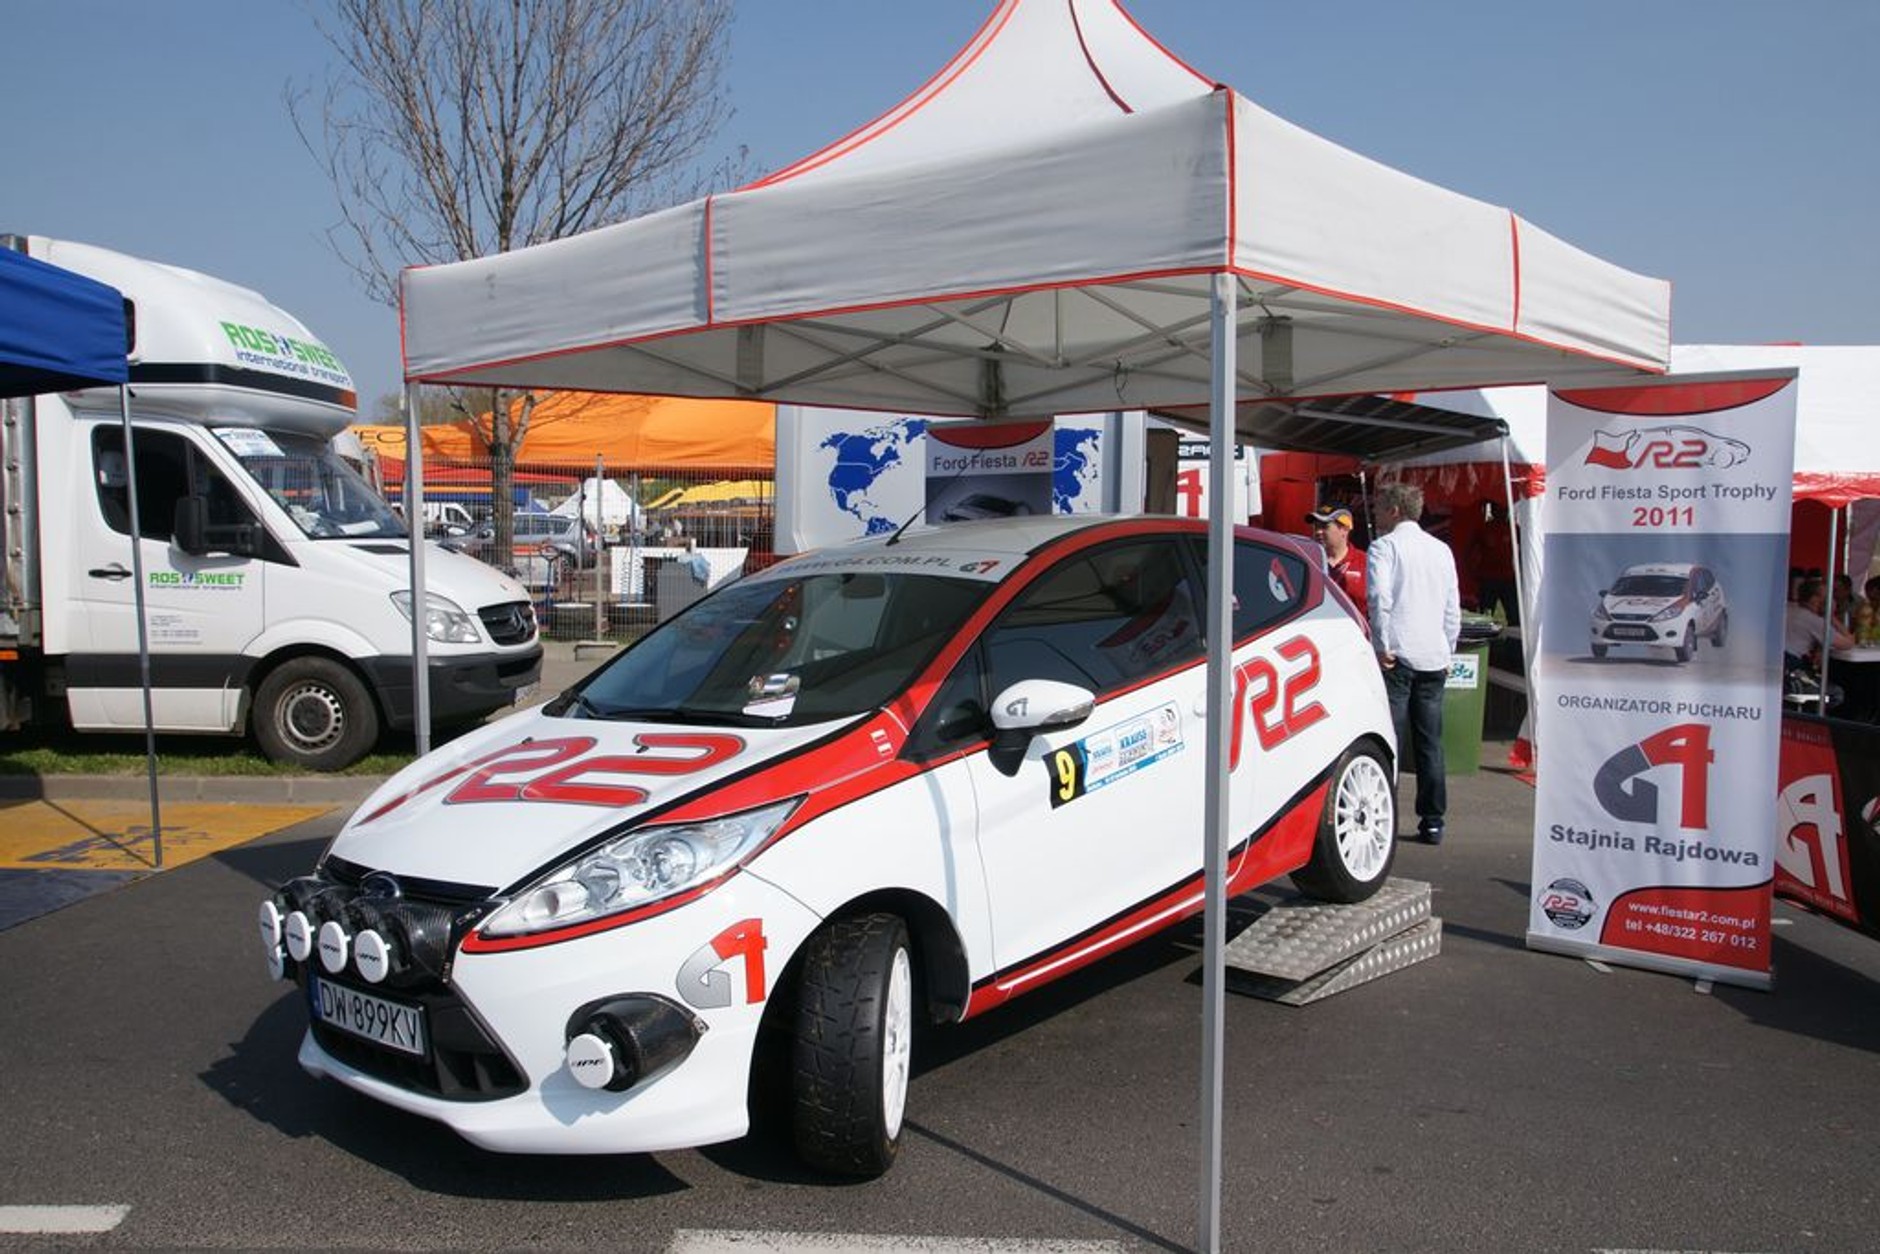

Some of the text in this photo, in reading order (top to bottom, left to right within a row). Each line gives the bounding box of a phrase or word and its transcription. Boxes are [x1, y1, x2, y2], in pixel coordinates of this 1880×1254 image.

[933, 456, 968, 471] Ford
[971, 455, 1017, 469] Fiesta
[1558, 483, 1778, 501] Ford Fiesta Sport Trophy
[1632, 506, 1694, 526] 2011
[1557, 694, 1762, 721] ORGANIZATOR PUCHARU
[1055, 750, 1076, 801] 9
[1550, 824, 1760, 867] Stajnia Rajdowa
[1628, 902, 1755, 930] www.fiestar2.com.pl
[1625, 918, 1757, 949] tel +48/322 267 012
[320, 982, 417, 1048] DW 899KV
